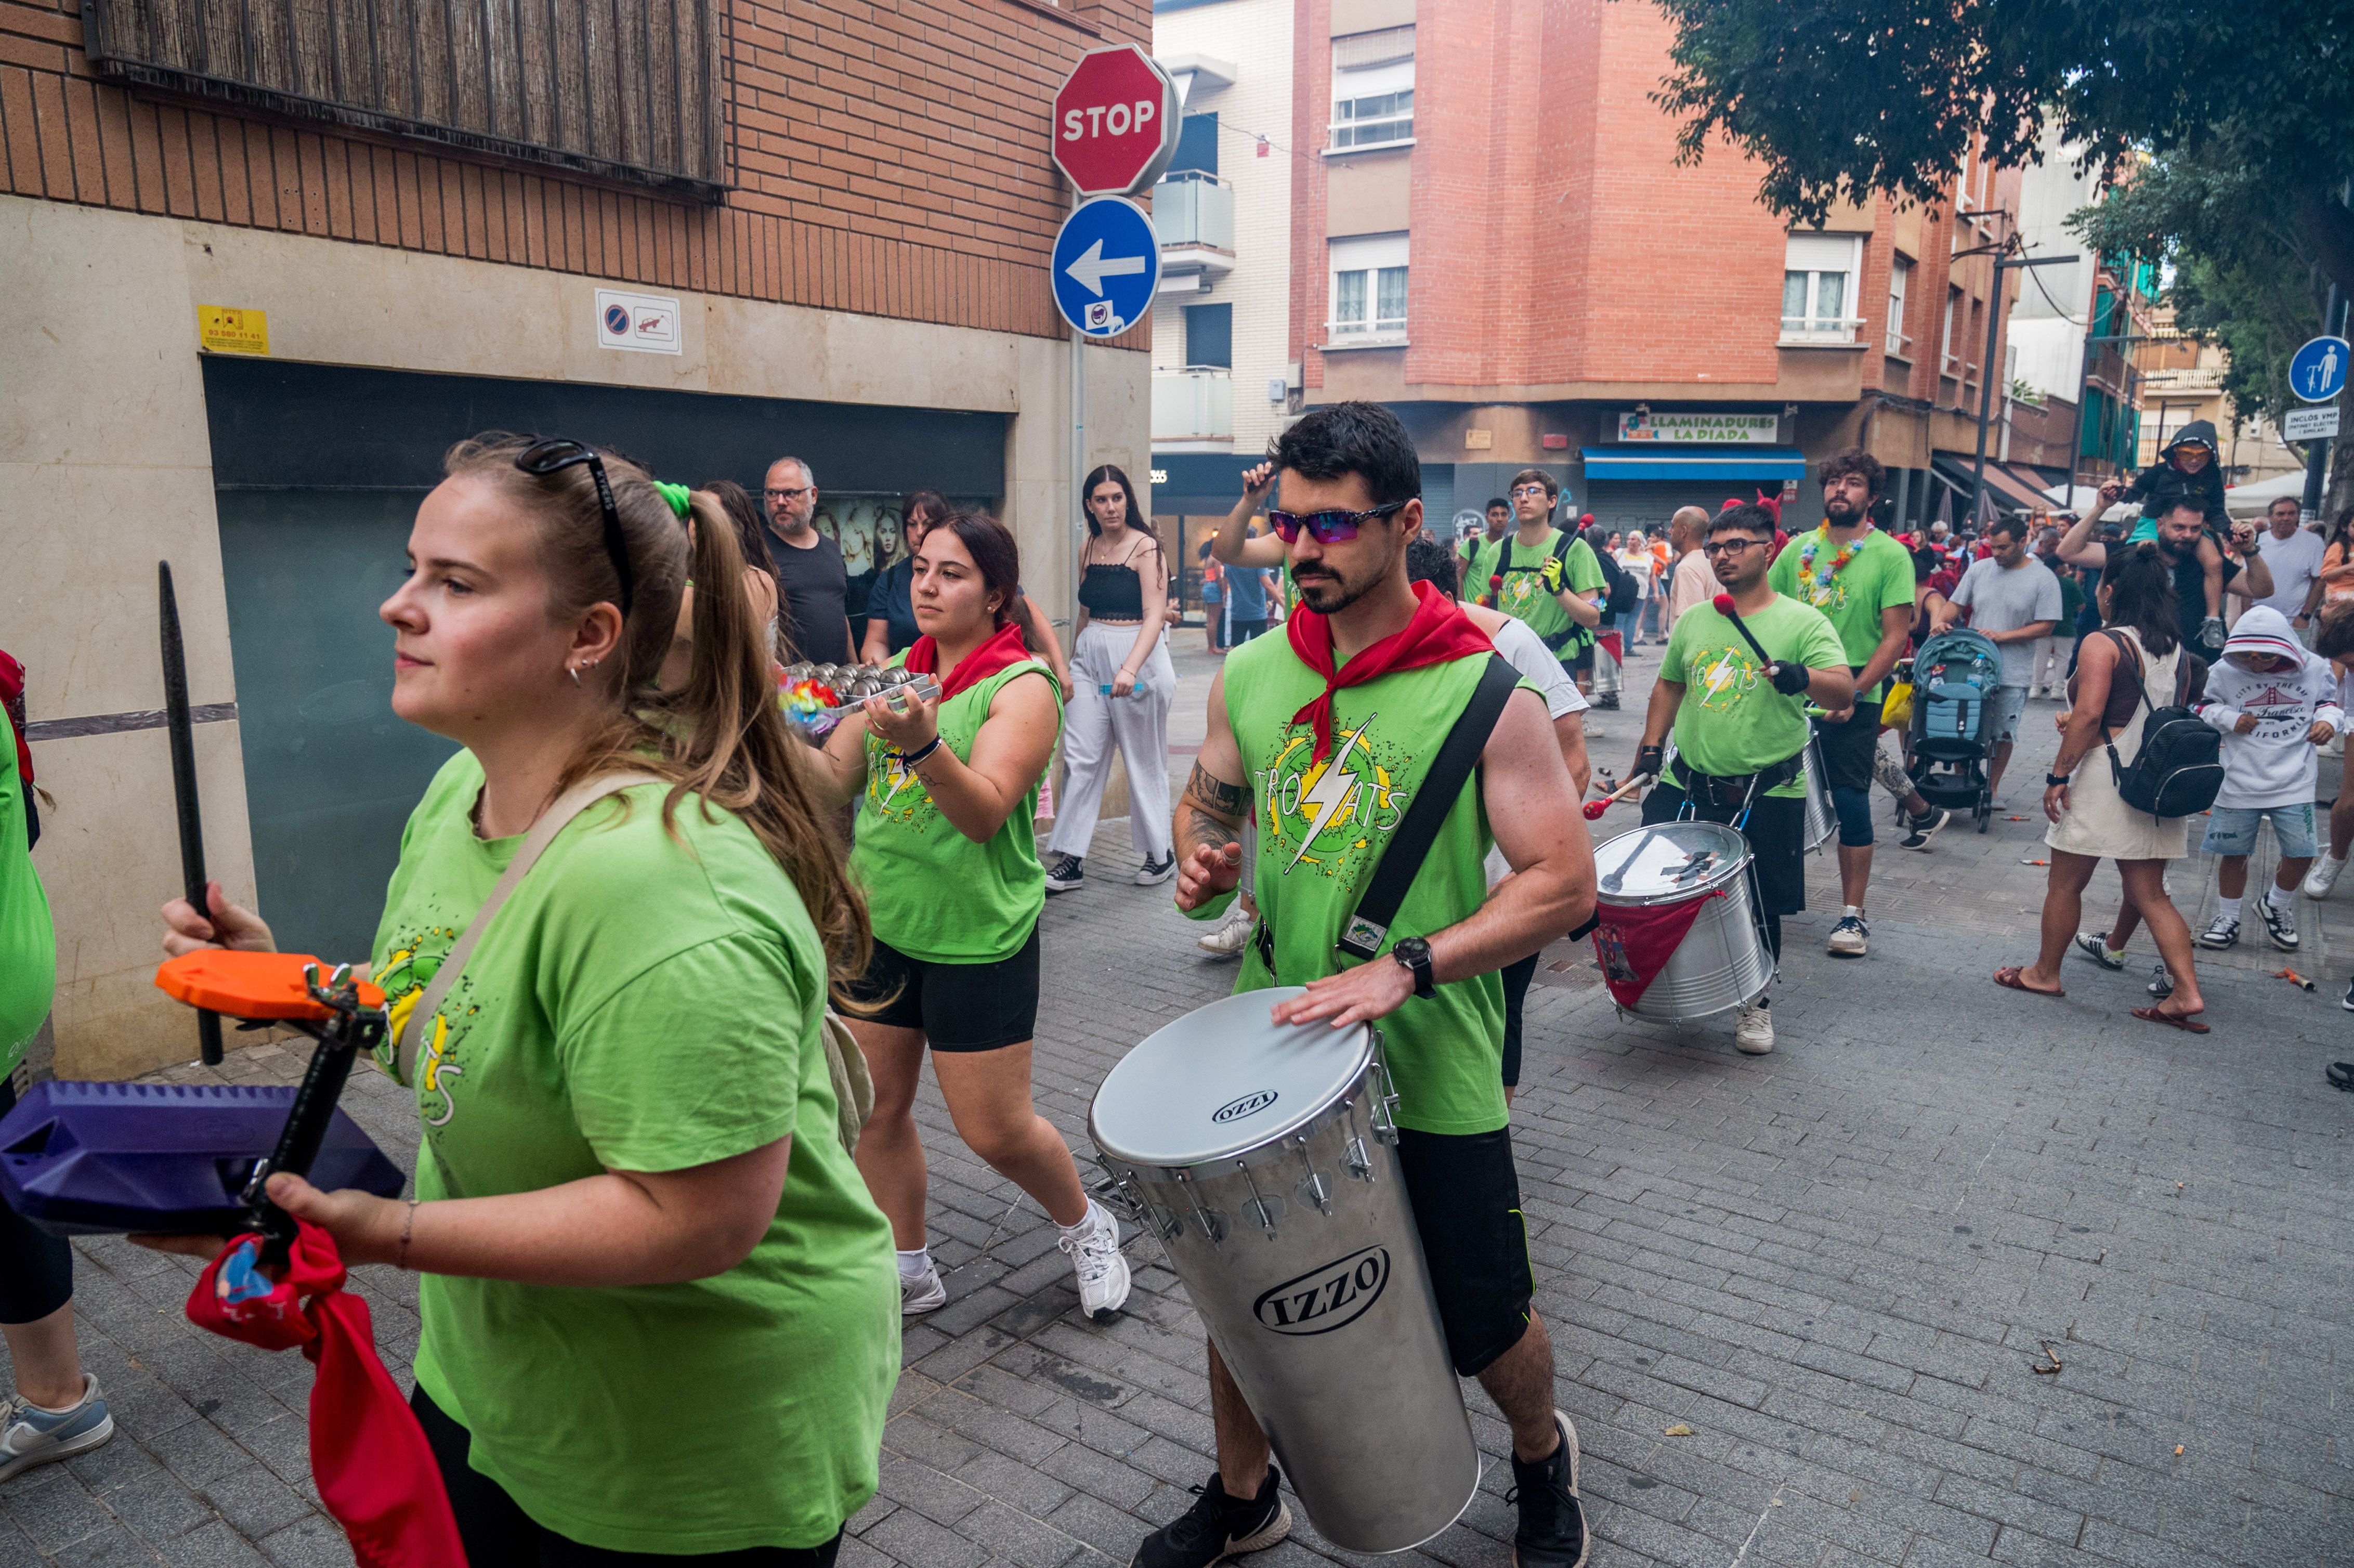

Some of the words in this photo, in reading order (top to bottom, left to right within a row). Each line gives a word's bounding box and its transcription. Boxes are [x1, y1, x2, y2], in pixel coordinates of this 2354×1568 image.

[1063, 100, 1155, 141] STOP
[1650, 416, 1774, 428] LLAMINADURES
[1674, 429, 1693, 440] LA
[1697, 429, 1749, 440] DIADA
[2236, 686, 2252, 699] CITY
[2296, 686, 2308, 697] BAY
[2257, 706, 2305, 716] Francisco
[1219, 1092, 1271, 1121] IZZO
[1267, 1257, 1379, 1326] IZZO
